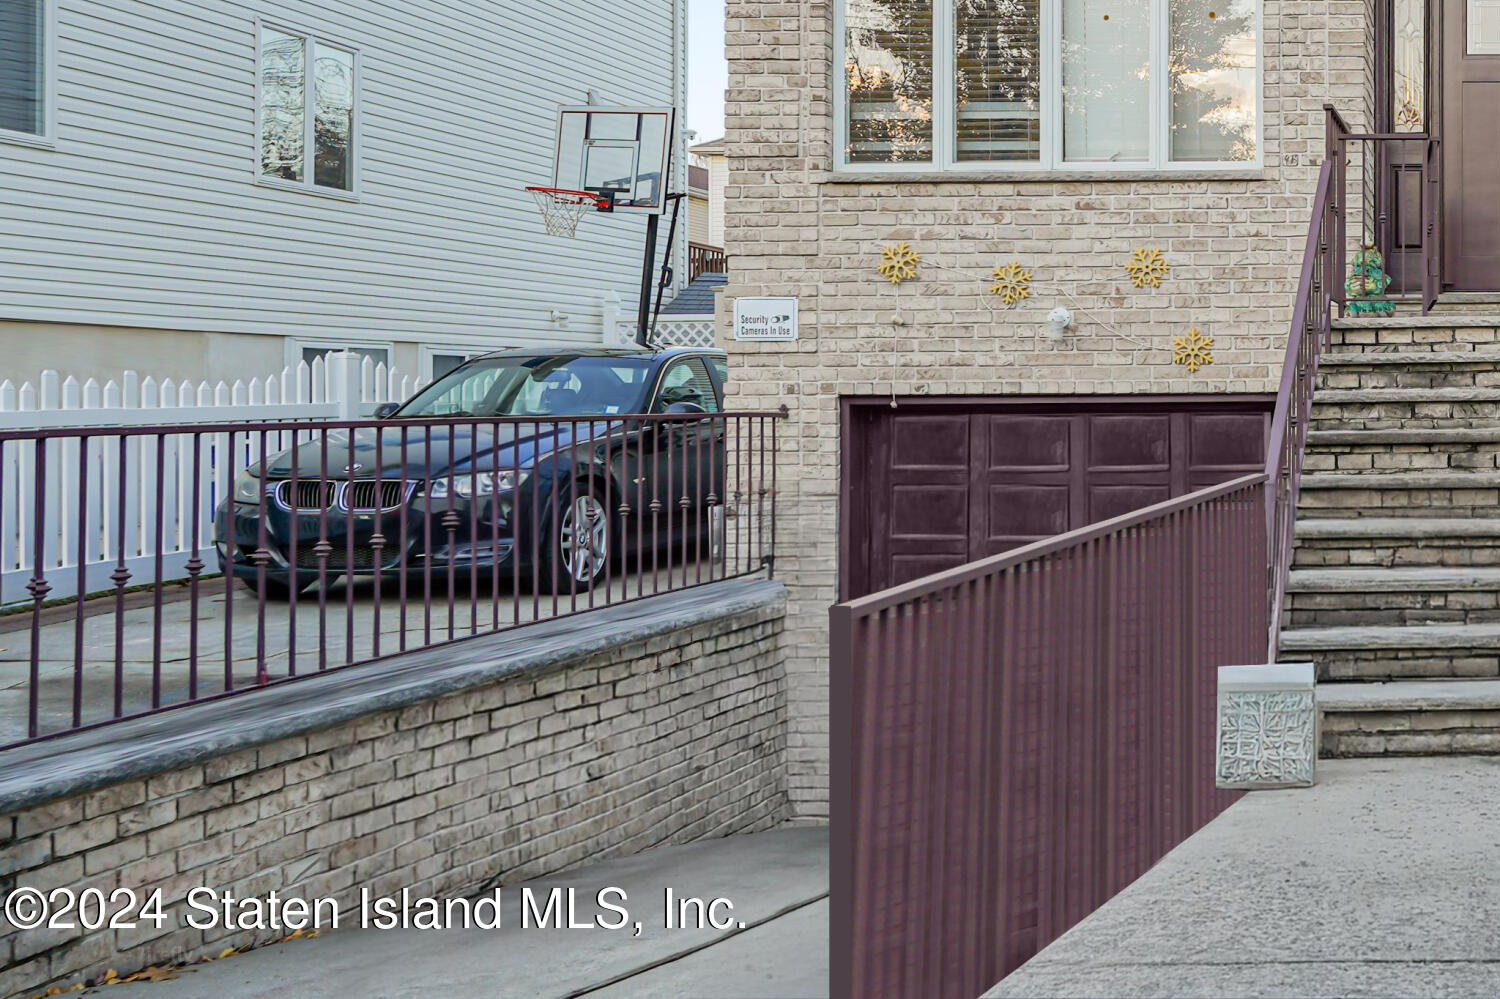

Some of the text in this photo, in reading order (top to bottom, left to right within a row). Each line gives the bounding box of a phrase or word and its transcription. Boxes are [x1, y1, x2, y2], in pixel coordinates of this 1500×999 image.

[741, 314, 769, 325] Security
[741, 326, 791, 335] Cameras In Use
